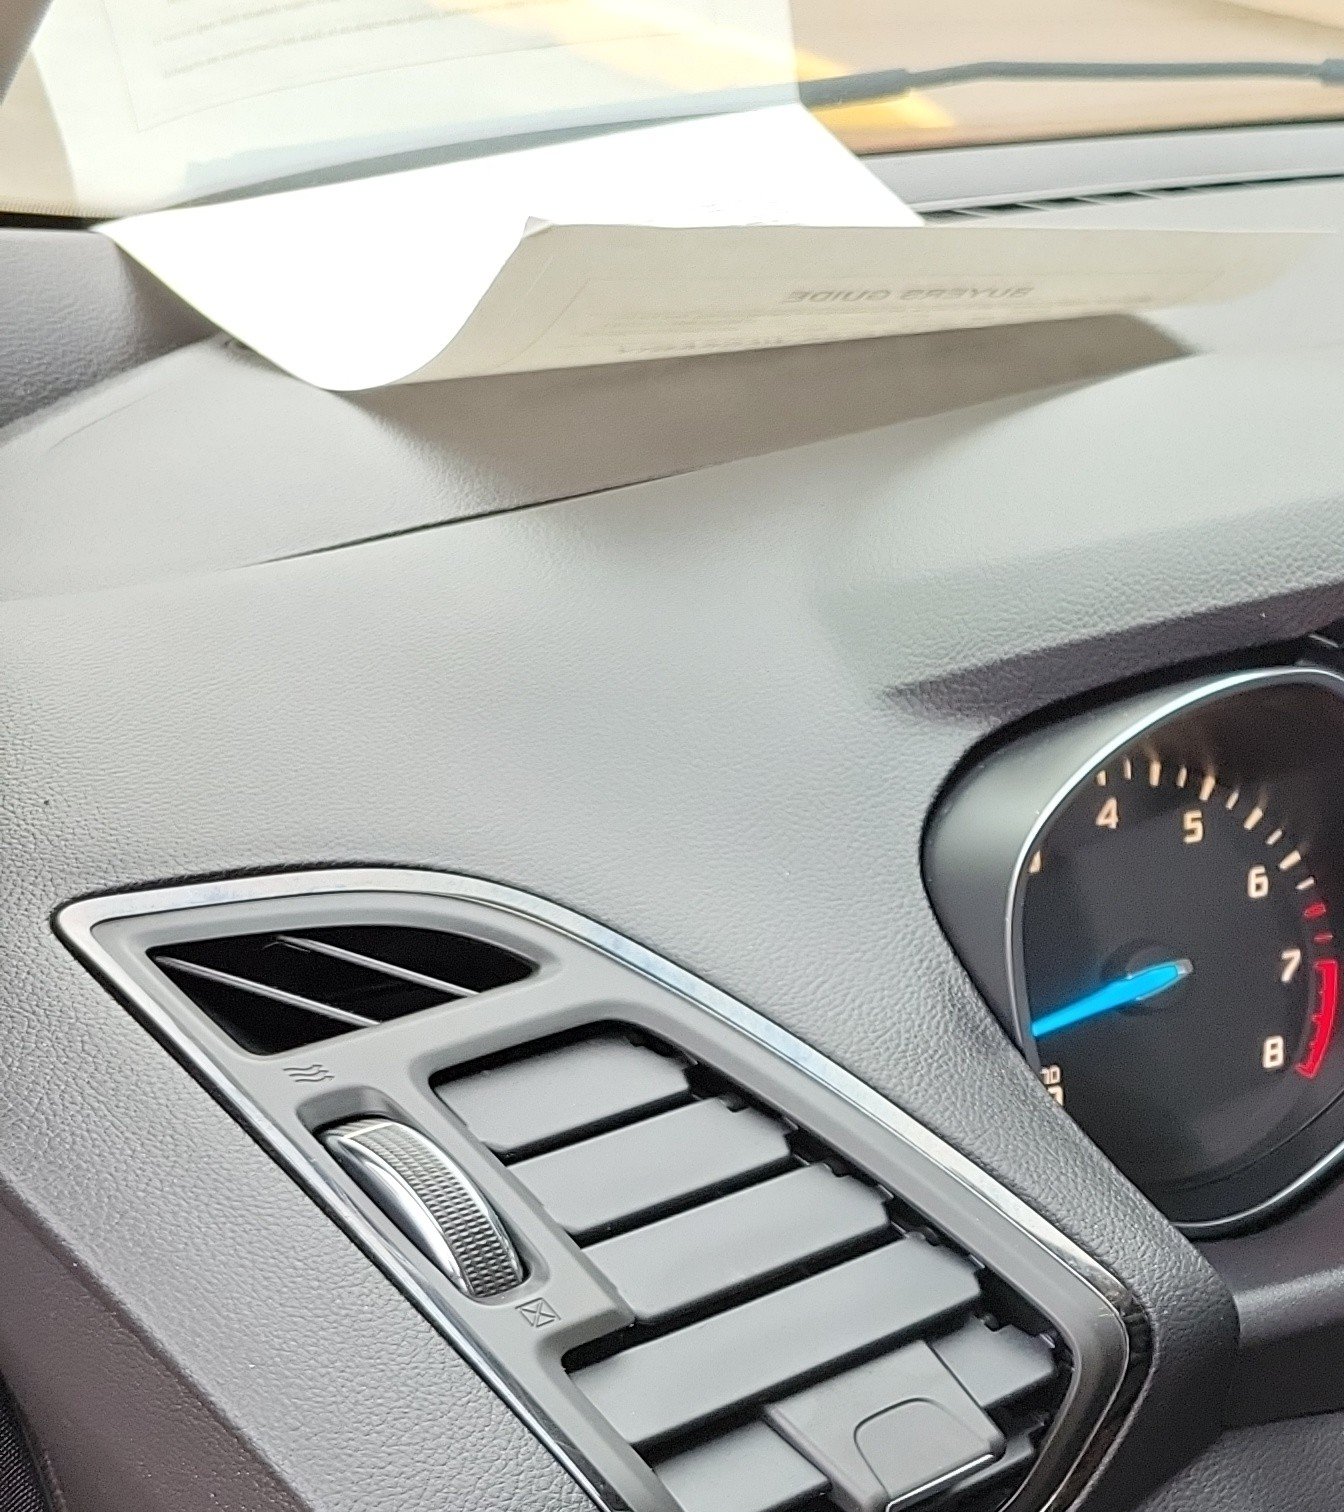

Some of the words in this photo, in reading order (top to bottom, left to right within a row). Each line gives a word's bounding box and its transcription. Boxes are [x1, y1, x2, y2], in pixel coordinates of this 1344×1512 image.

[1096, 797, 1119, 829] 4
[1184, 810, 1204, 844] 5
[1248, 866, 1269, 899] 6
[1281, 949, 1301, 983] 7
[1263, 1036, 1284, 1069] 8
